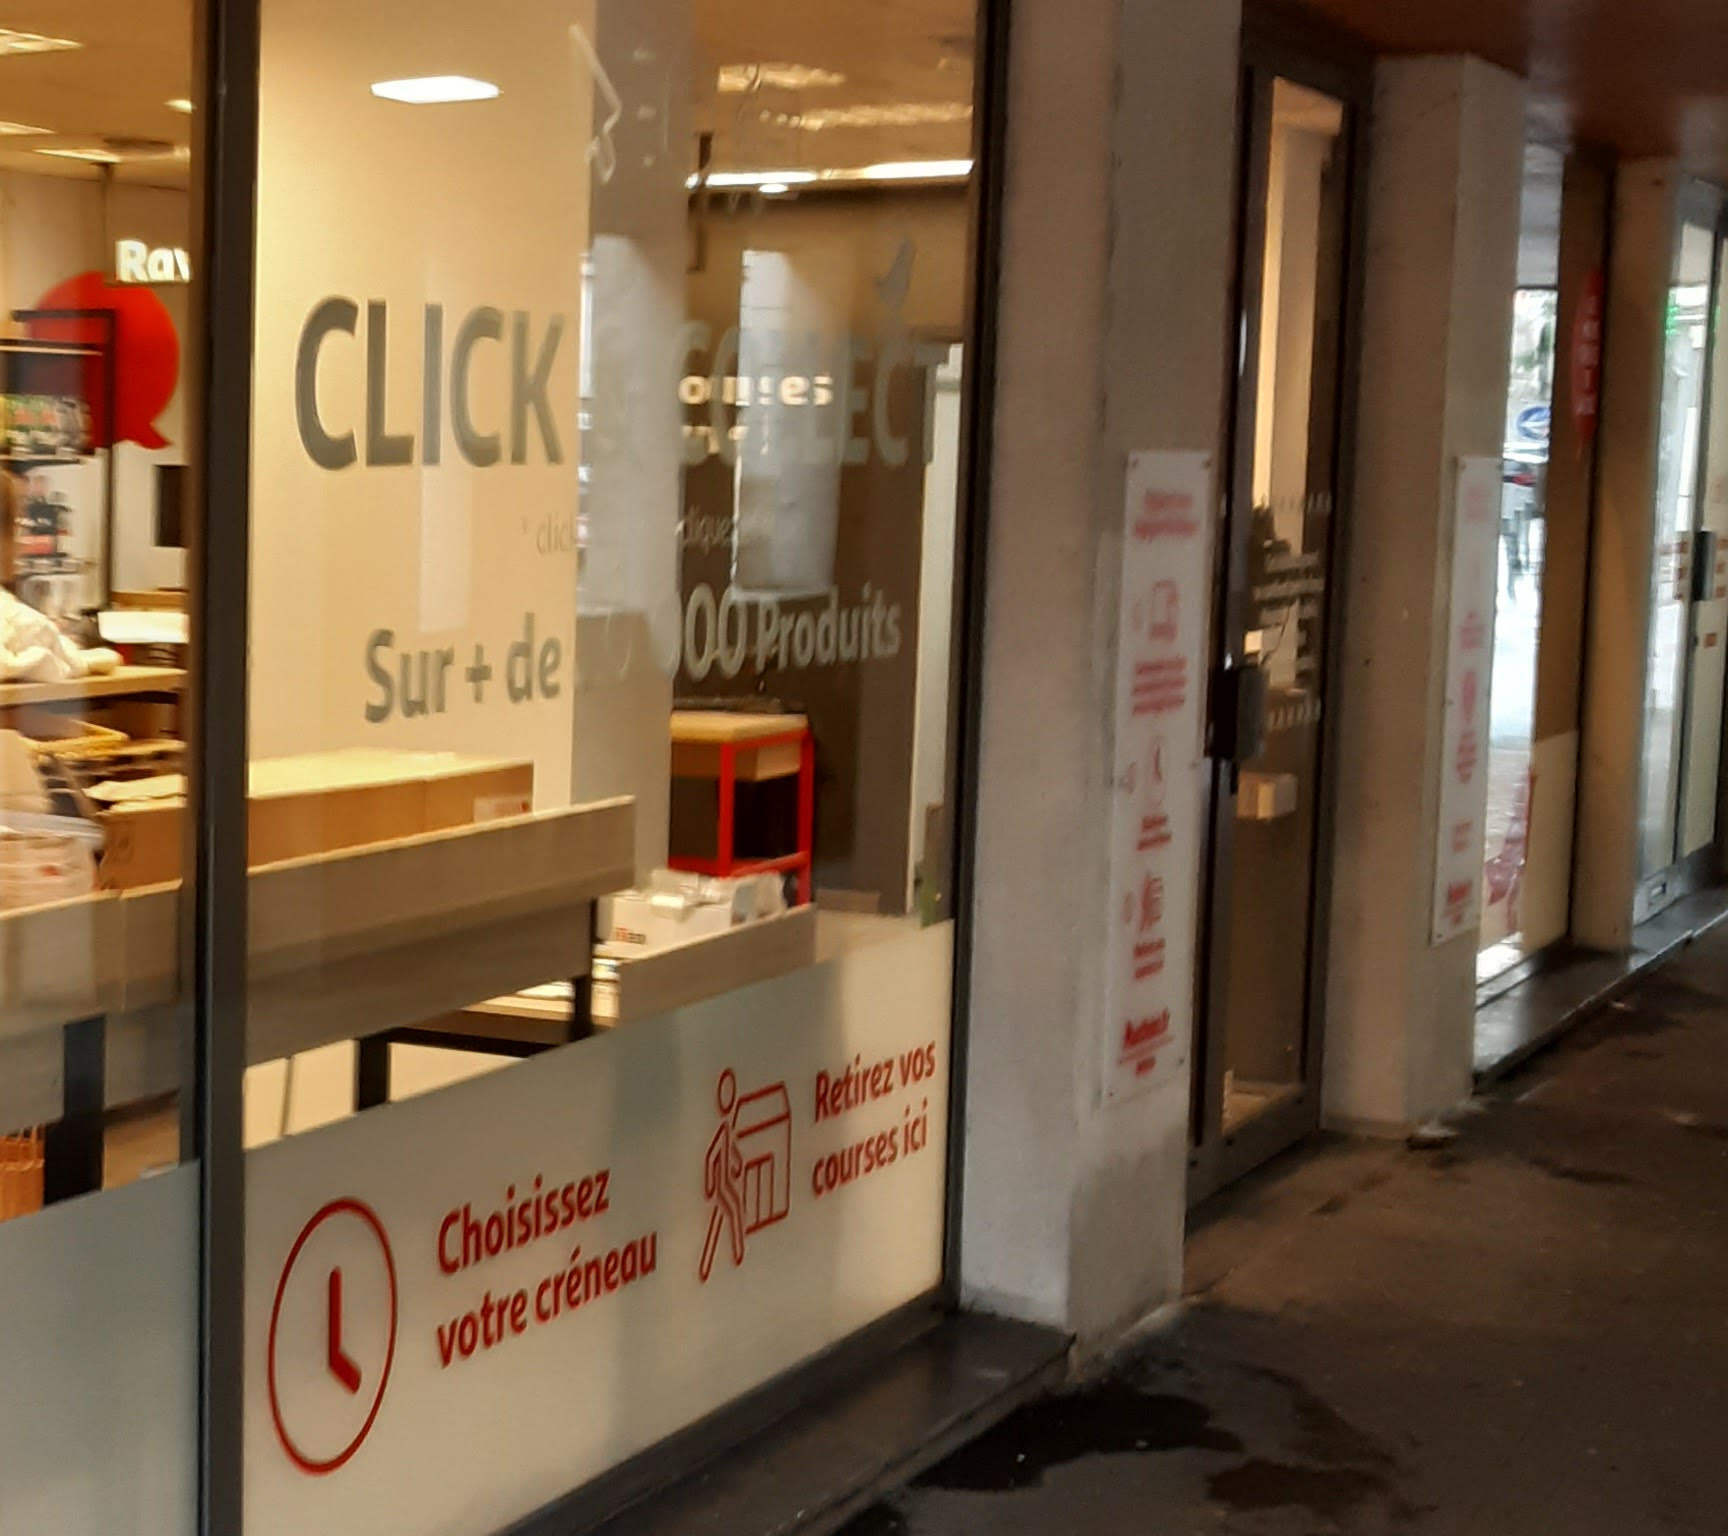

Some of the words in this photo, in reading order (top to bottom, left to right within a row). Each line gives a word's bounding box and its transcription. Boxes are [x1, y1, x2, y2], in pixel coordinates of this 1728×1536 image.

[294, 293, 565, 471] CLICK
[364, 627, 456, 724] Sur
[465, 643, 493, 704] +
[505, 611, 563, 704] de
[752, 580, 906, 678] Produits
[815, 1056, 895, 1125] Retirez
[899, 1040, 937, 1083] vos
[811, 1124, 899, 1197] courses
[902, 1100, 928, 1158] ici
[436, 1167, 610, 1276] Choisissez
[435, 1287, 527, 1368] votre
[534, 1230, 658, 1326] créneau
